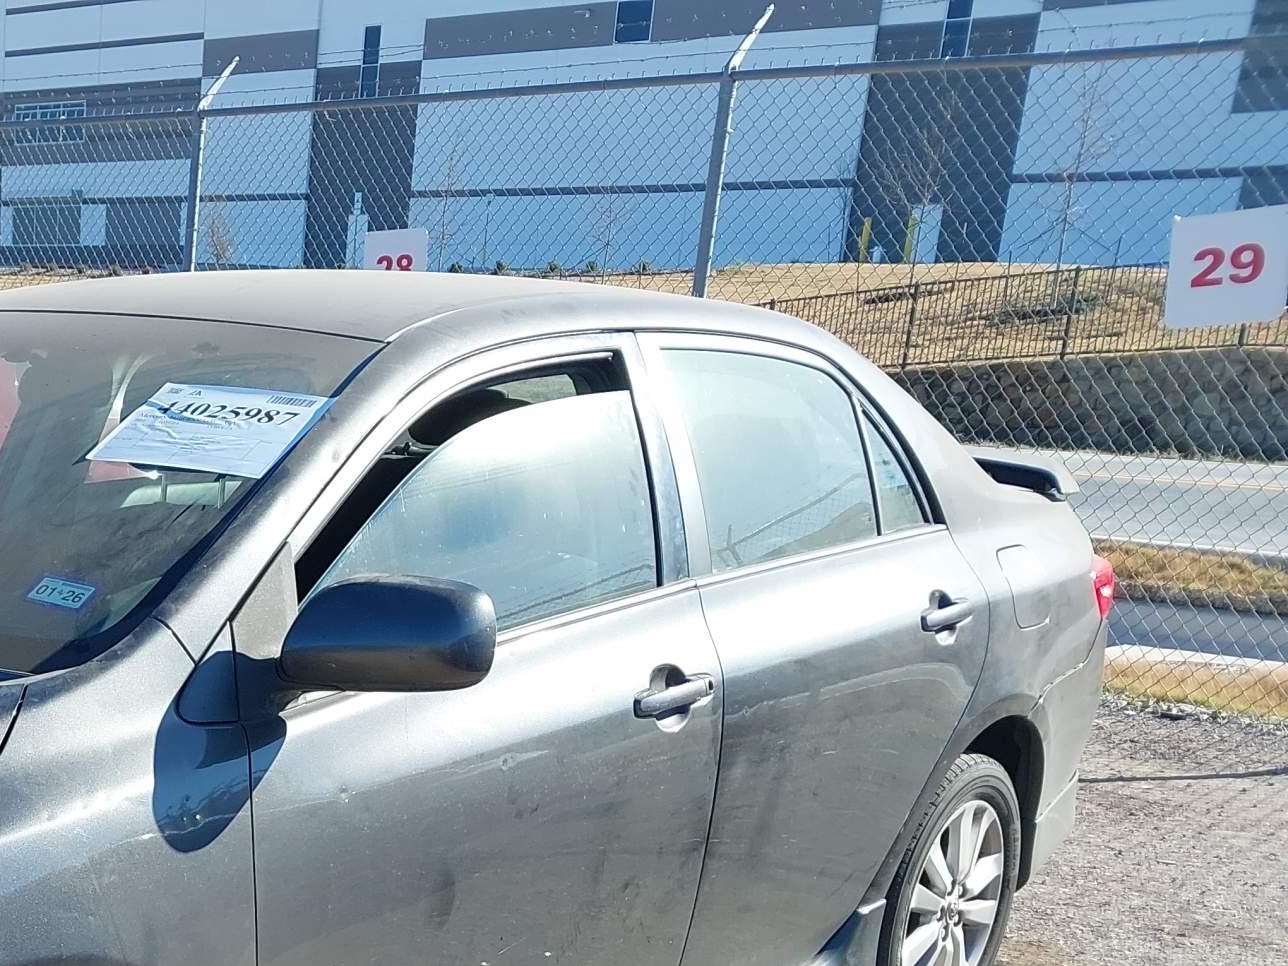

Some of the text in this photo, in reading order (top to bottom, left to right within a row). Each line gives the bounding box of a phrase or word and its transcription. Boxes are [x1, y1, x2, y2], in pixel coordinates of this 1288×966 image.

[1190, 242, 1265, 289] 29
[157, 400, 300, 426] 44025987
[35, 584, 86, 603] 01 26
